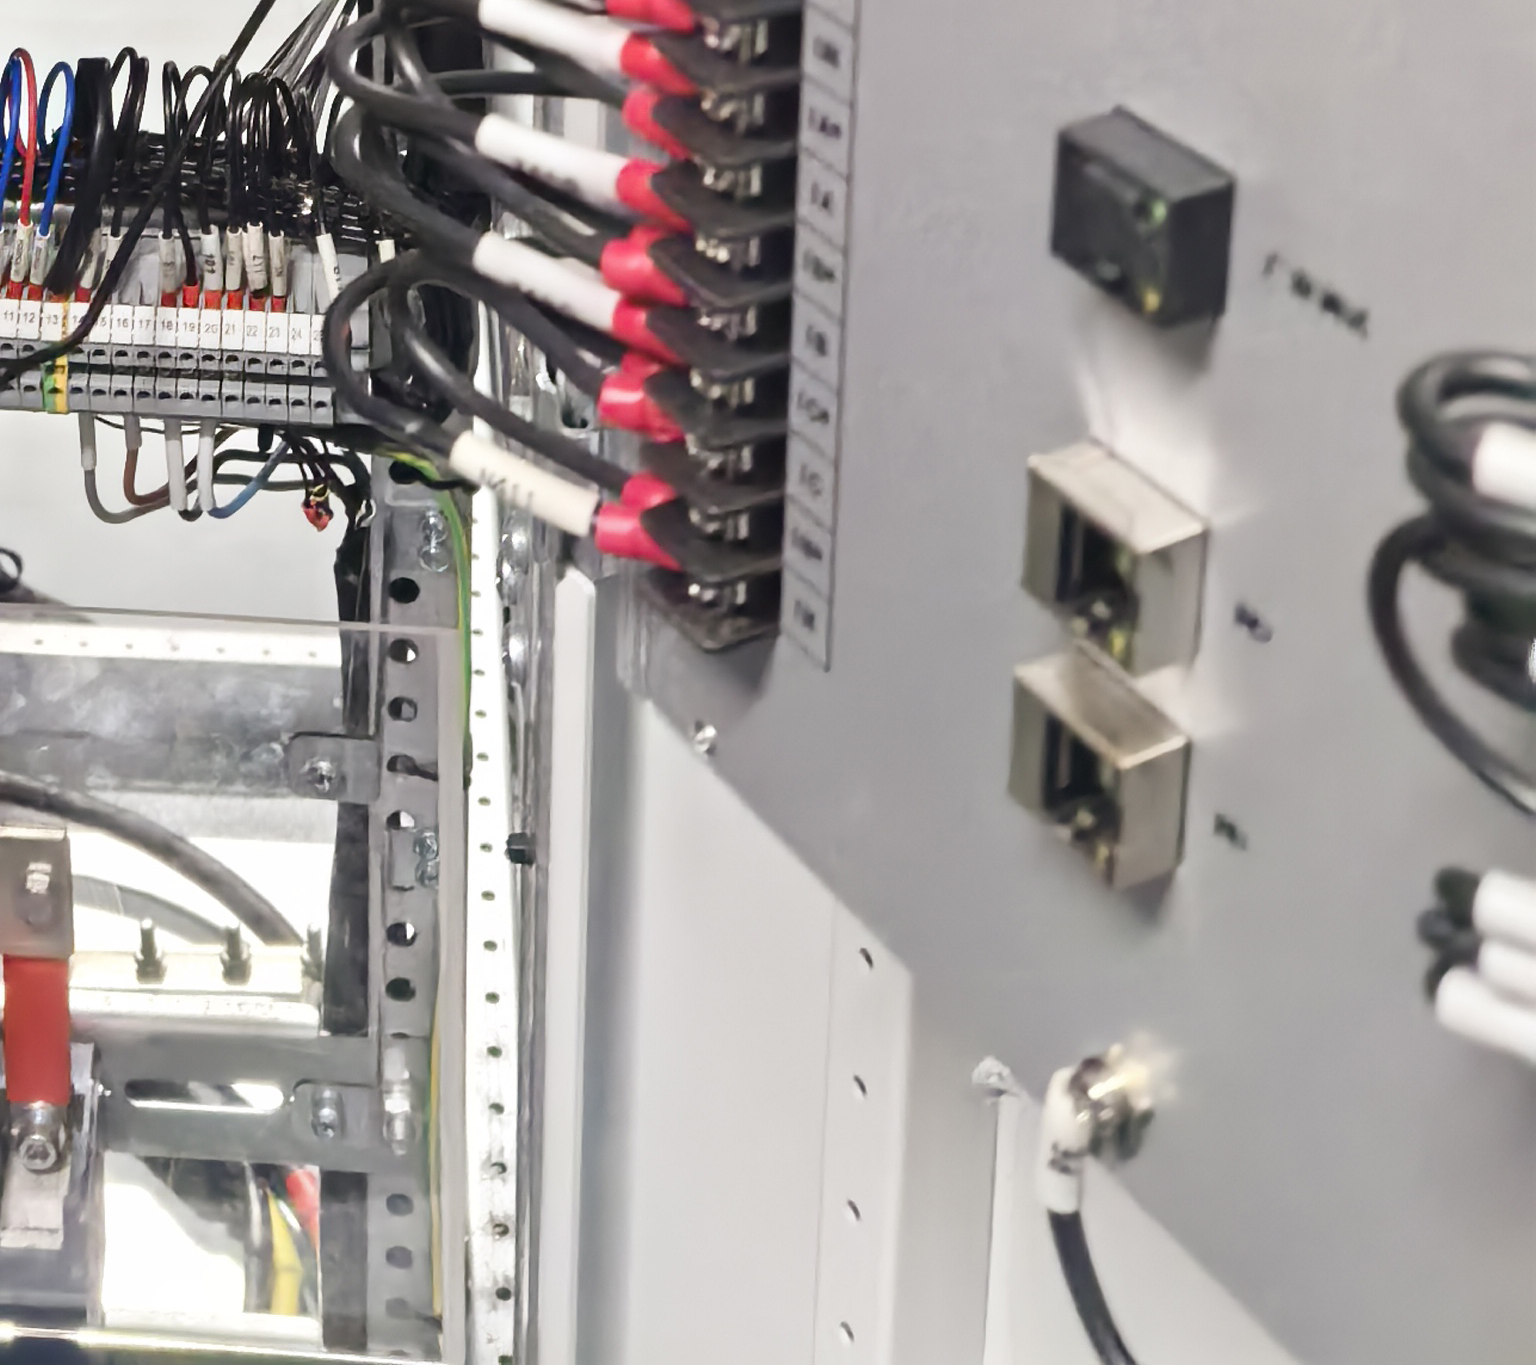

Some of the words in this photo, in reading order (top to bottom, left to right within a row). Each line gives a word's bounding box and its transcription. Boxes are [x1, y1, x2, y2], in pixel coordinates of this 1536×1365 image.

[3, 310, 14, 321] 11
[23, 312, 36, 324] 12
[46, 314, 58, 325] 13
[116, 317, 129, 328] 16
[138, 319, 152, 330] 17
[161, 319, 174, 331] 18
[183, 321, 195, 333] 19
[204, 323, 218, 334] 20
[224, 323, 236, 335] 21
[246, 325, 258, 337] 22
